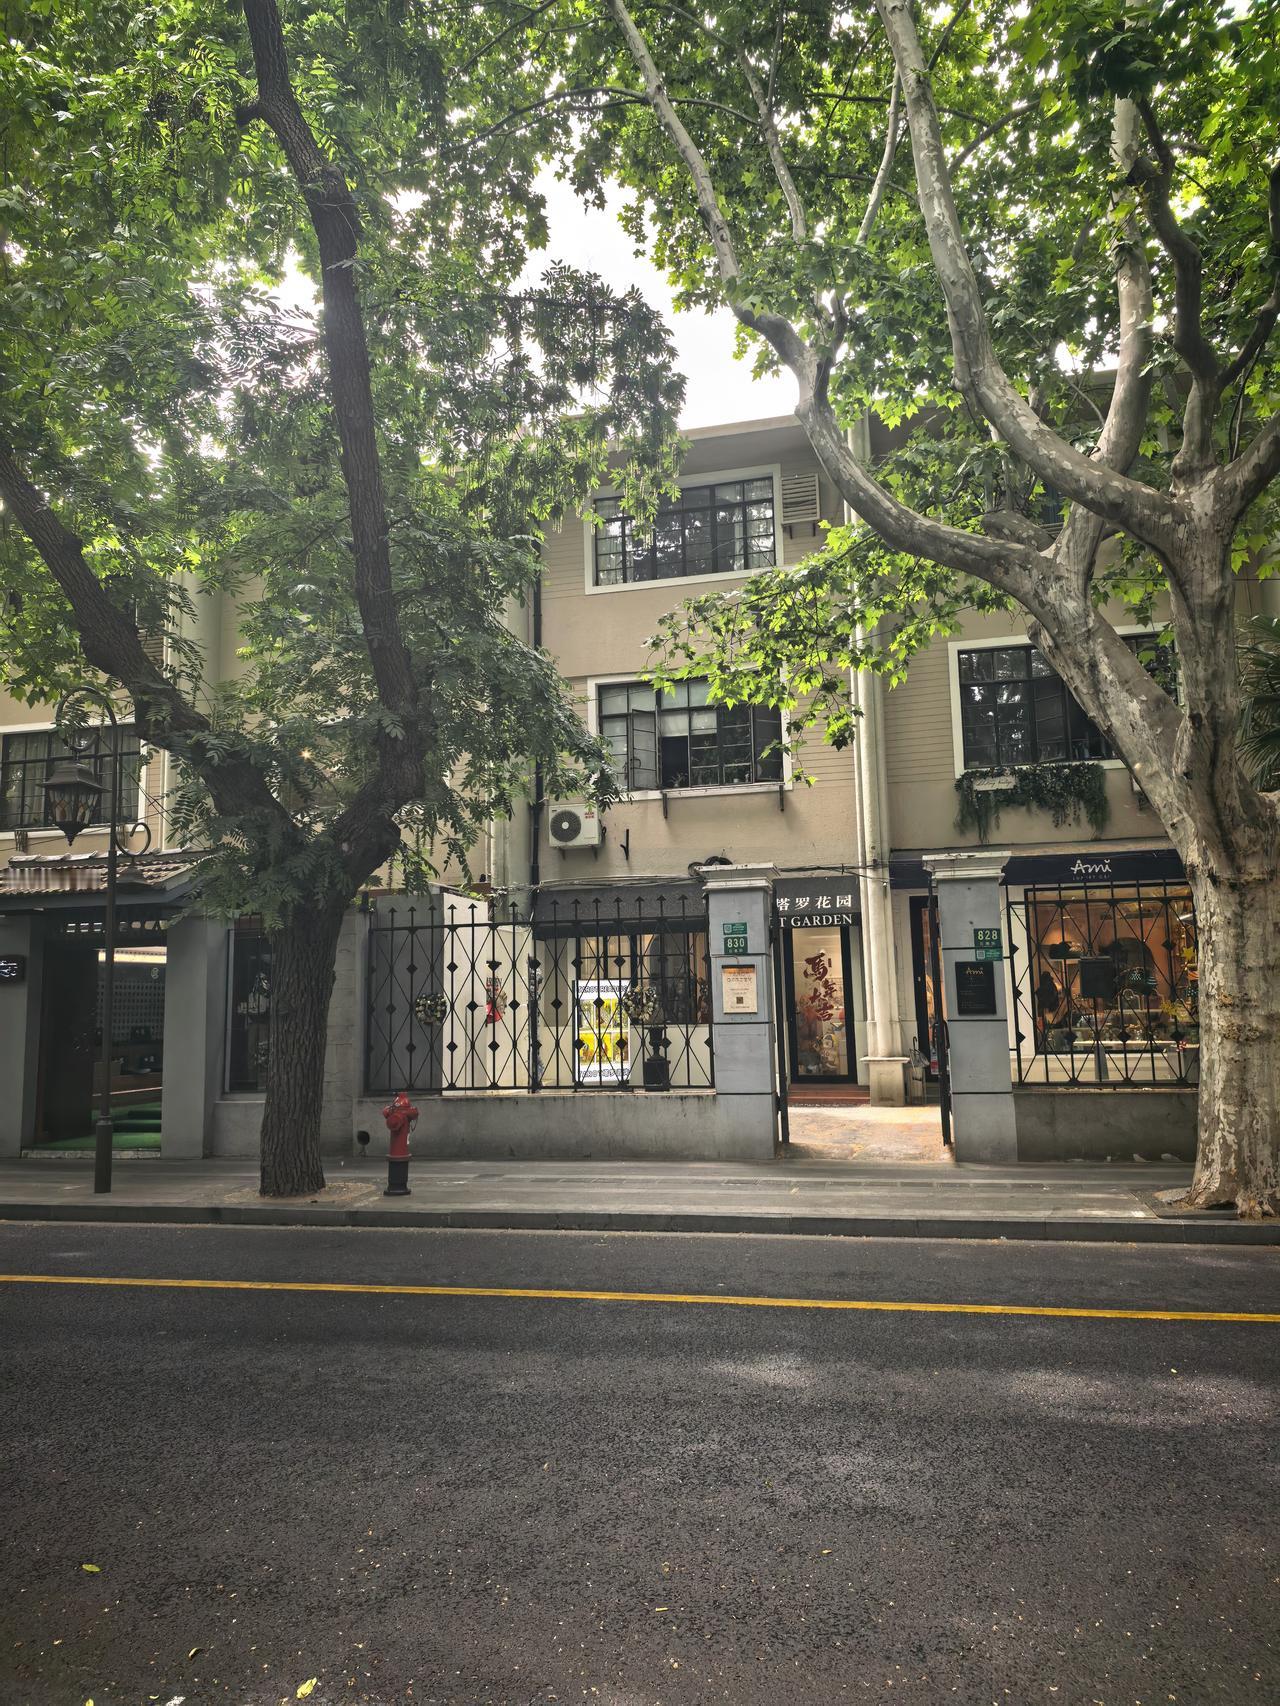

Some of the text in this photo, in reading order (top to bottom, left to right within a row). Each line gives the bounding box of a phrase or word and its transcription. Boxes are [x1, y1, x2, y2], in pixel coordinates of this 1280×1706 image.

[1070, 859, 1112, 874] Ami
[776, 894, 852, 911] 塔罗花园
[790, 913, 853, 927] GARDEN
[977, 930, 998, 941] 828
[727, 938, 745, 948] 830
